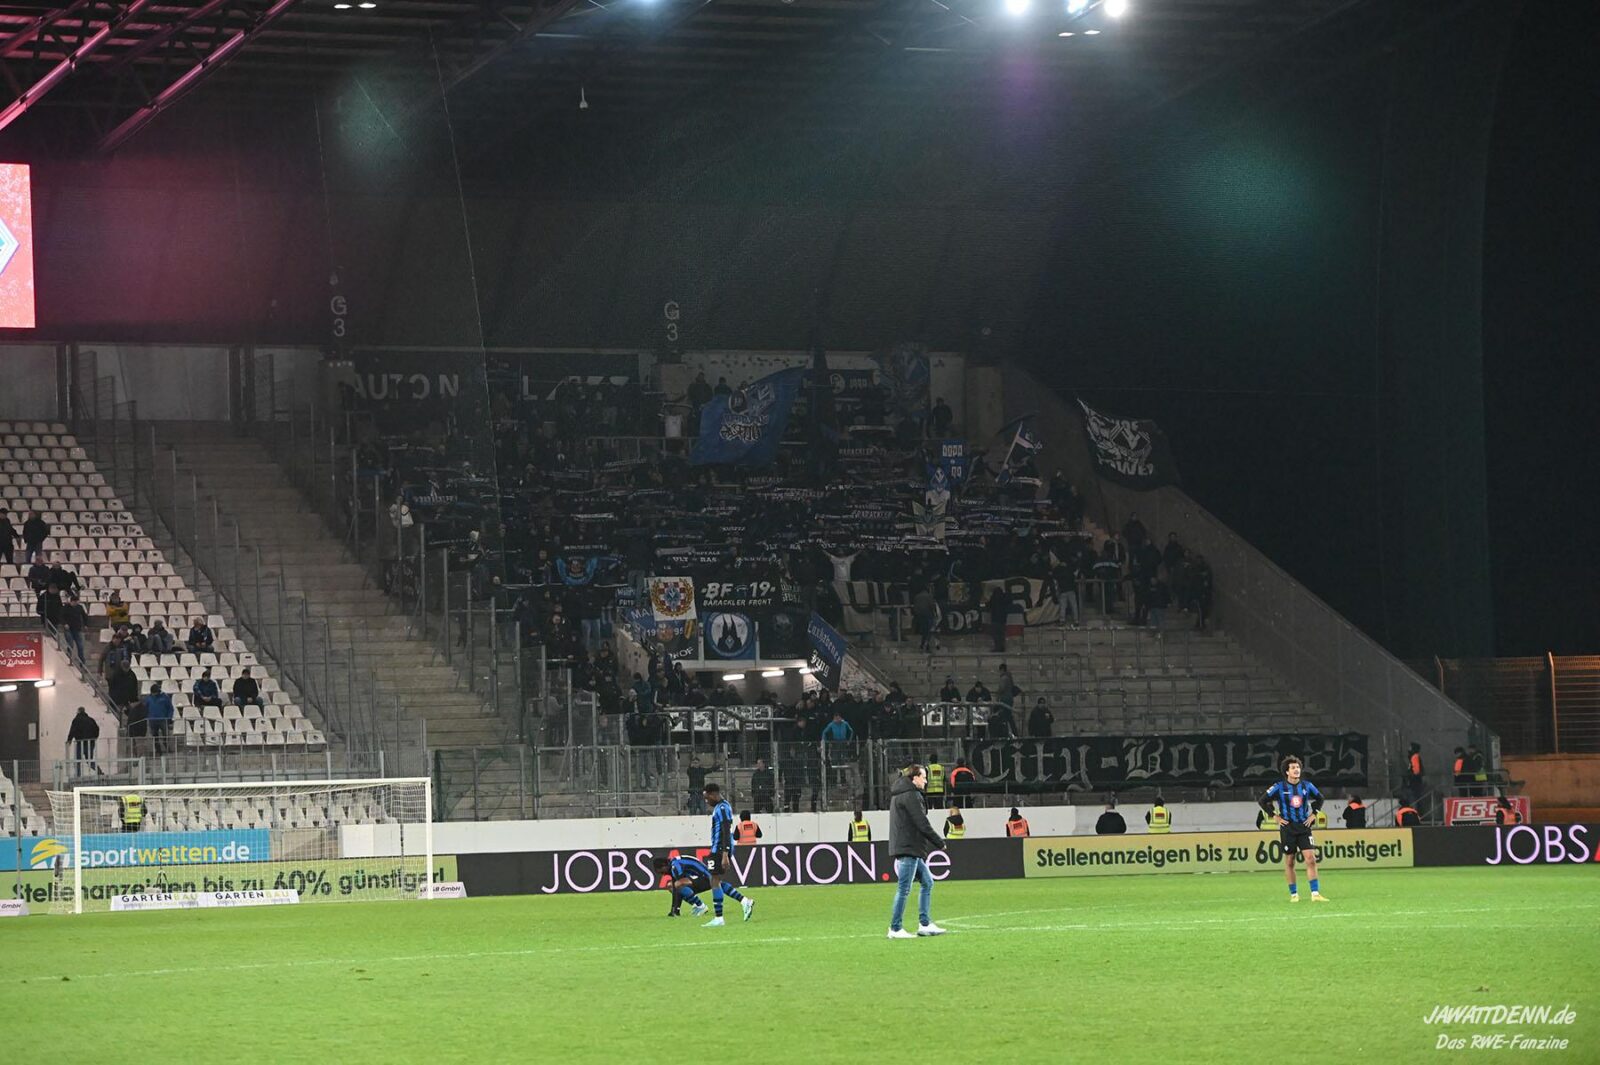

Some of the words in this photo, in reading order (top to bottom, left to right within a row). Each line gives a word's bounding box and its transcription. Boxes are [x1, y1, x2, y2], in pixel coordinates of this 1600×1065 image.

[702, 599, 746, 607] BARACKLER
[748, 598, 773, 606] FRONT
[80, 841, 250, 868] sportwetten.de
[1037, 846, 1191, 868] Stellenanzeigen
[1196, 844, 1223, 862] bis
[1228, 847, 1249, 861] zu
[1486, 825, 1600, 865] JOBS
